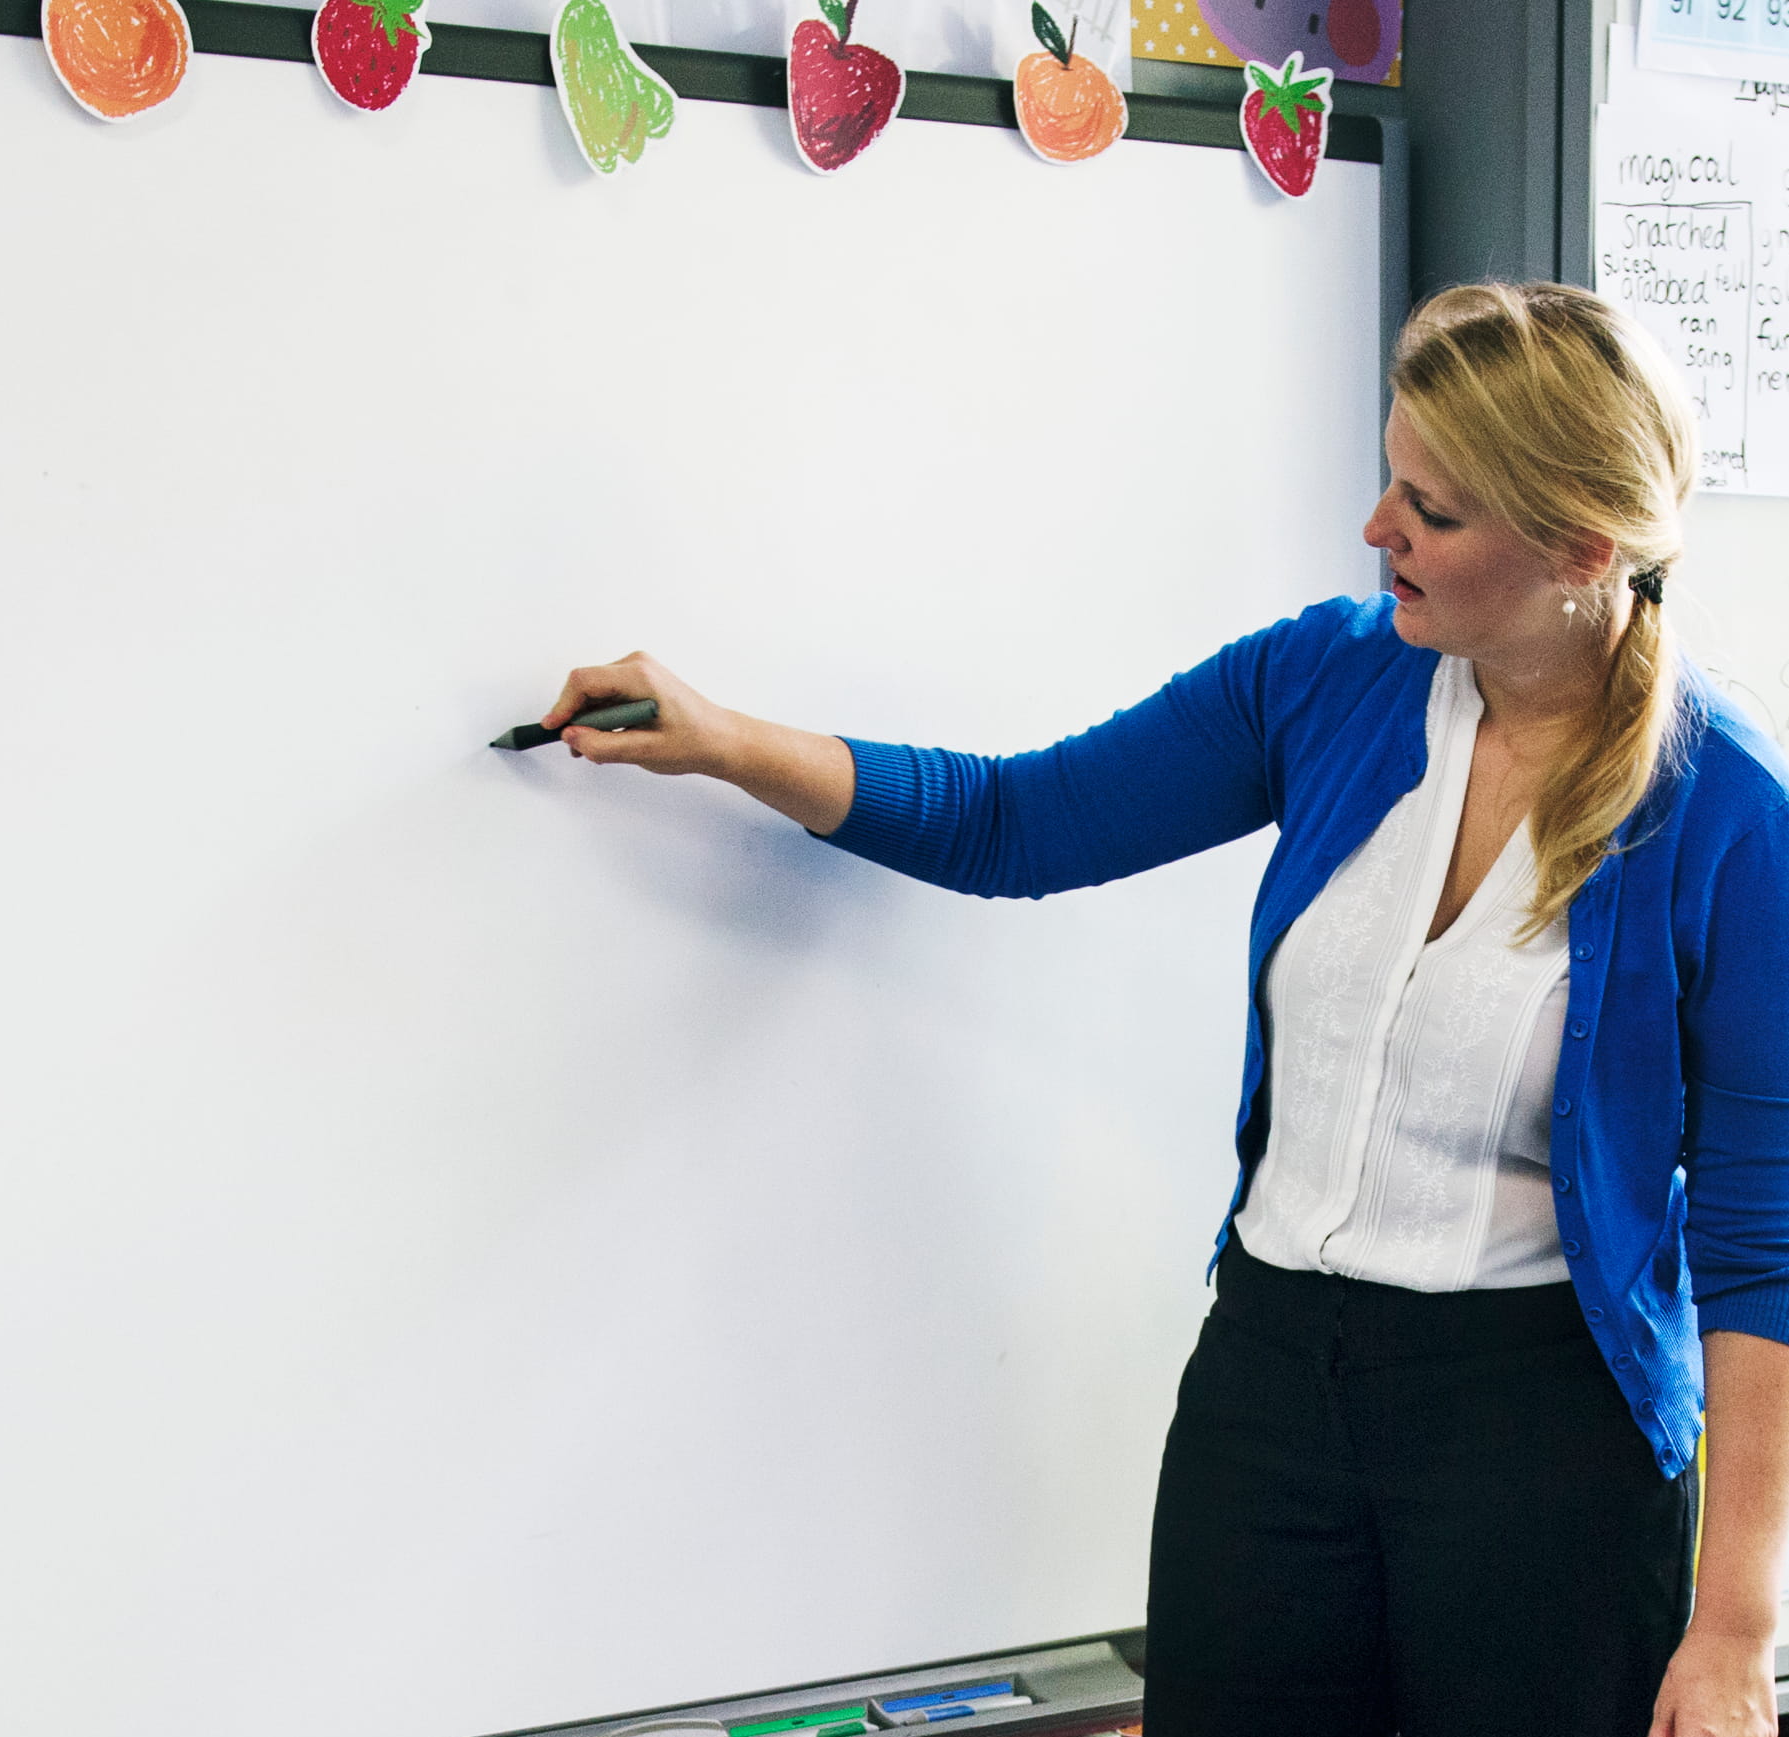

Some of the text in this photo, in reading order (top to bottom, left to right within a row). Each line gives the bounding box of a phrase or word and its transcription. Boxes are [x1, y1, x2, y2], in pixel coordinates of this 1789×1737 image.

[1618, 140, 1740, 202] magical
[1679, 313, 1718, 336] ran
[1685, 343, 1734, 391] sang
